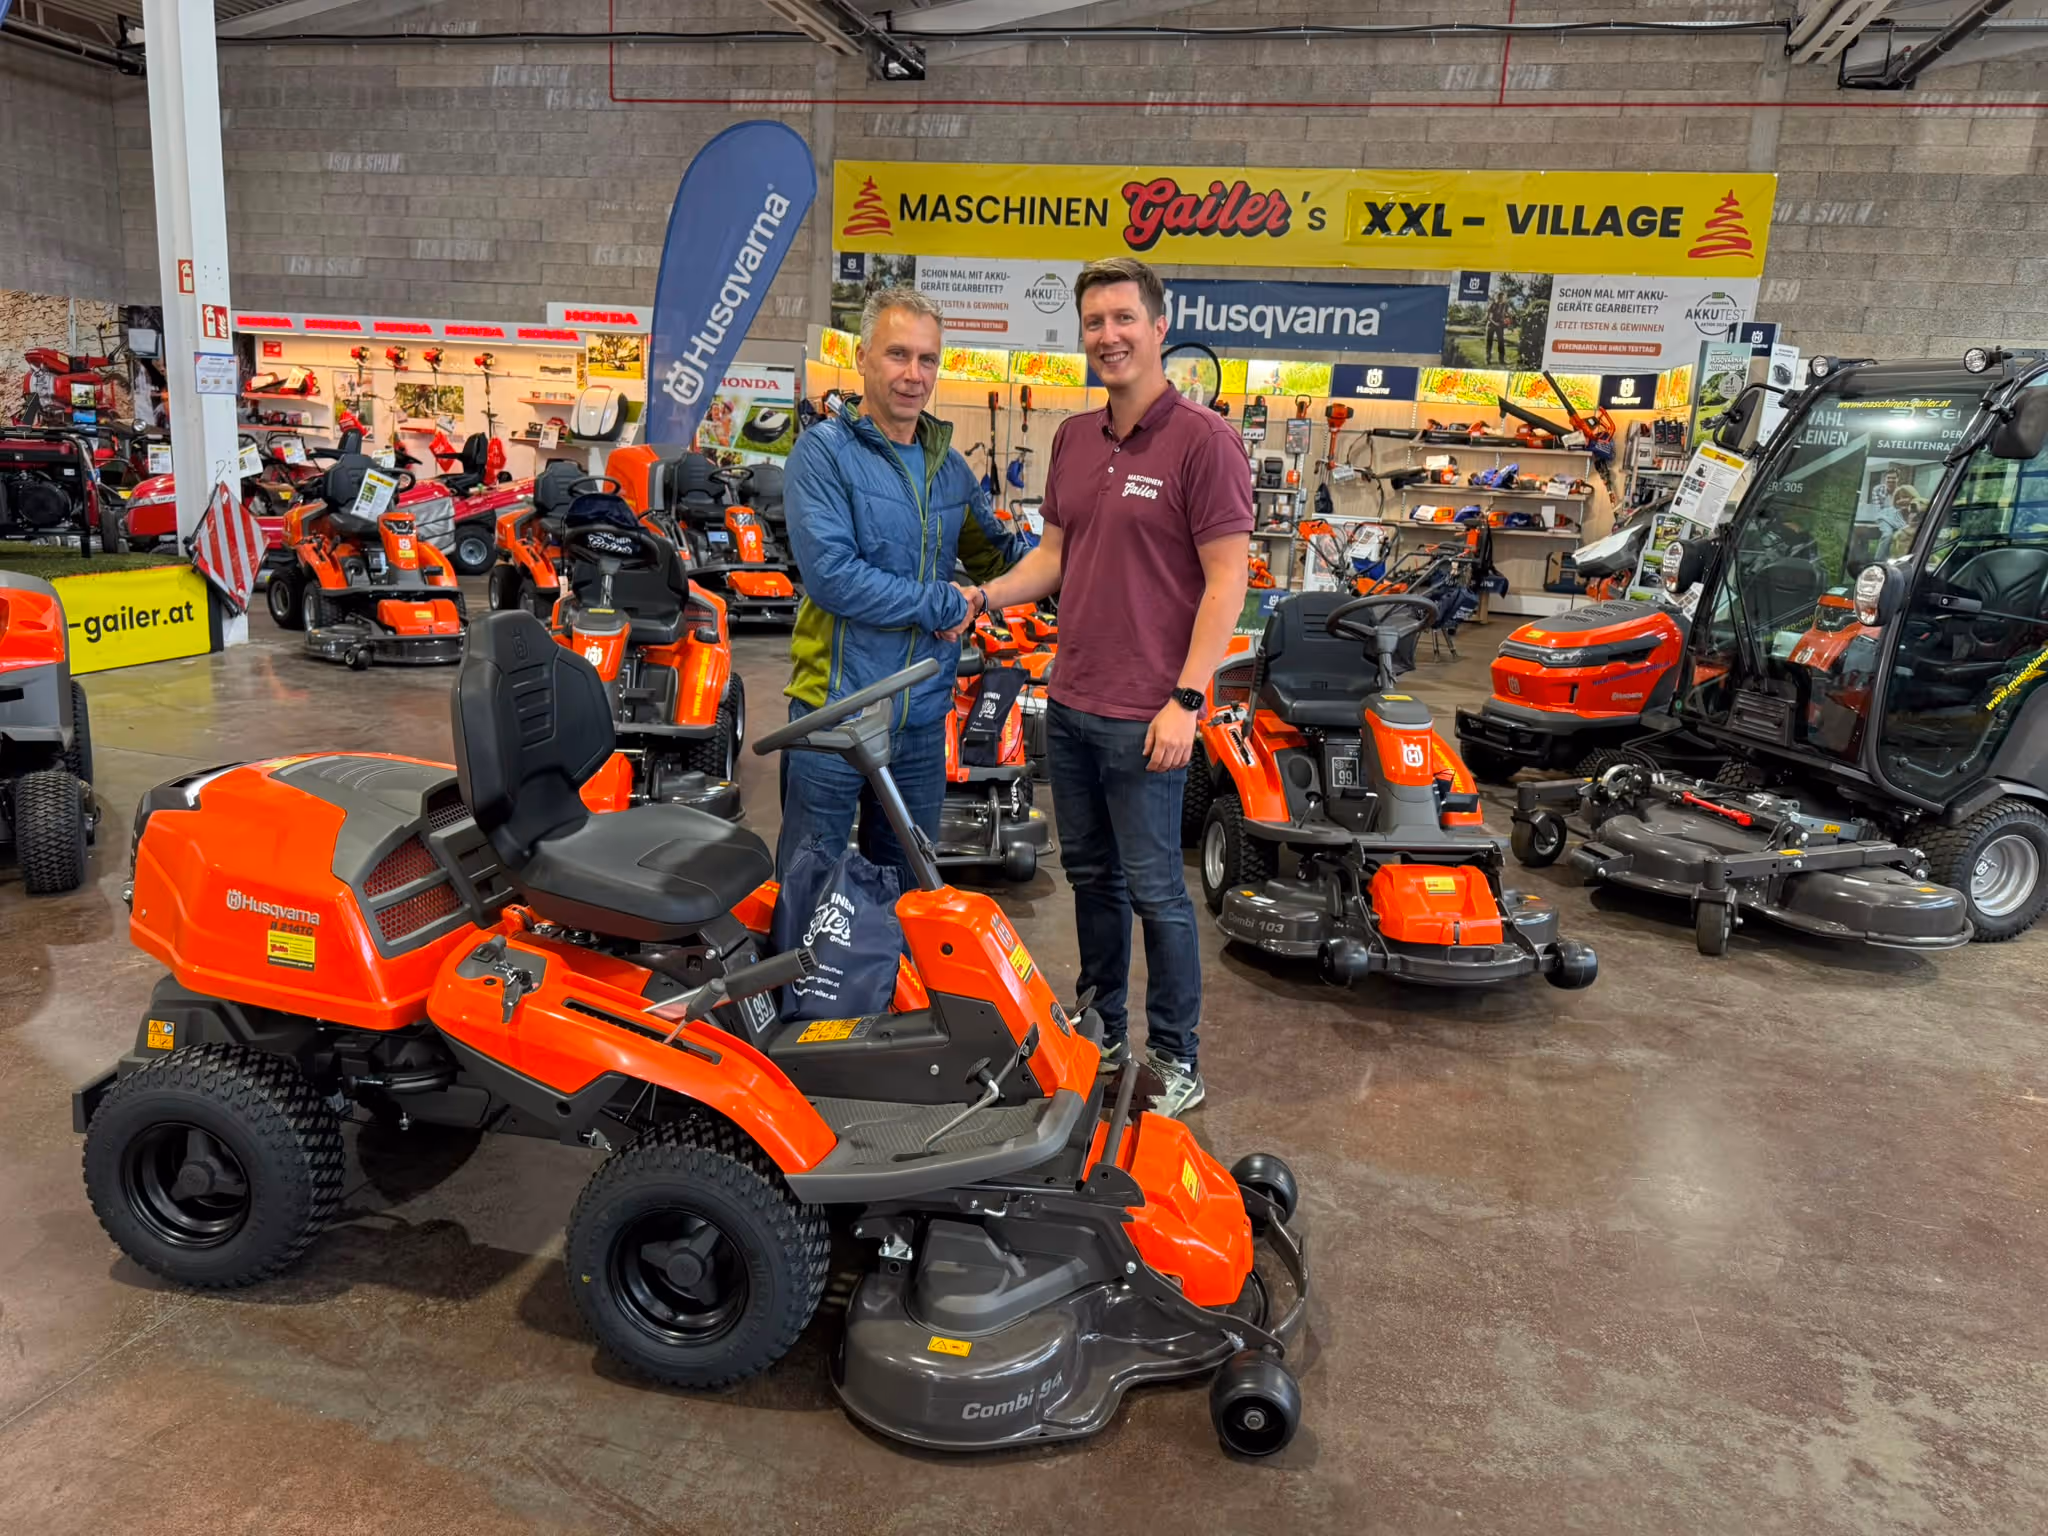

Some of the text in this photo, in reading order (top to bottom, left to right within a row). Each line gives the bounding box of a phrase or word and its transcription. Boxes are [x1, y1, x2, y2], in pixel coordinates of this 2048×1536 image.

[900, 192, 1109, 228] MASCHINEN
[1121, 177, 1293, 252] Gailer
[1360, 201, 1453, 237] XXL
[1507, 203, 1684, 238] VILLAGE
[921, 268, 1011, 281] SCHON MAL MIT AKKU-
[683, 192, 790, 371] Husqvarna
[920, 280, 1004, 294] GERÄTE GEARBEITET?
[1024, 288, 1074, 300] AKKUTEST
[1559, 288, 1669, 301] SCHON MAL MIT AKKU-
[941, 300, 967, 309] TESTEN
[973, 301, 1009, 311] GEWINNEN
[1557, 301, 1659, 315] GERÄTE GEARBEITET?
[564, 310, 638, 325] HONDA
[1176, 295, 1380, 339] Husqvarna
[1684, 308, 1747, 321] AKKUTEST
[1555, 320, 1665, 333] JETZT TESTEN & GEWINNEN
[1127, 474, 1163, 487] MASCHINEN
[1121, 482, 1158, 499] Gailer
[1783, 482, 1803, 494] 305
[242, 894, 320, 925] Husqvarna
[1258, 920, 1285, 933] 103
[961, 1388, 1035, 1420] Combi
